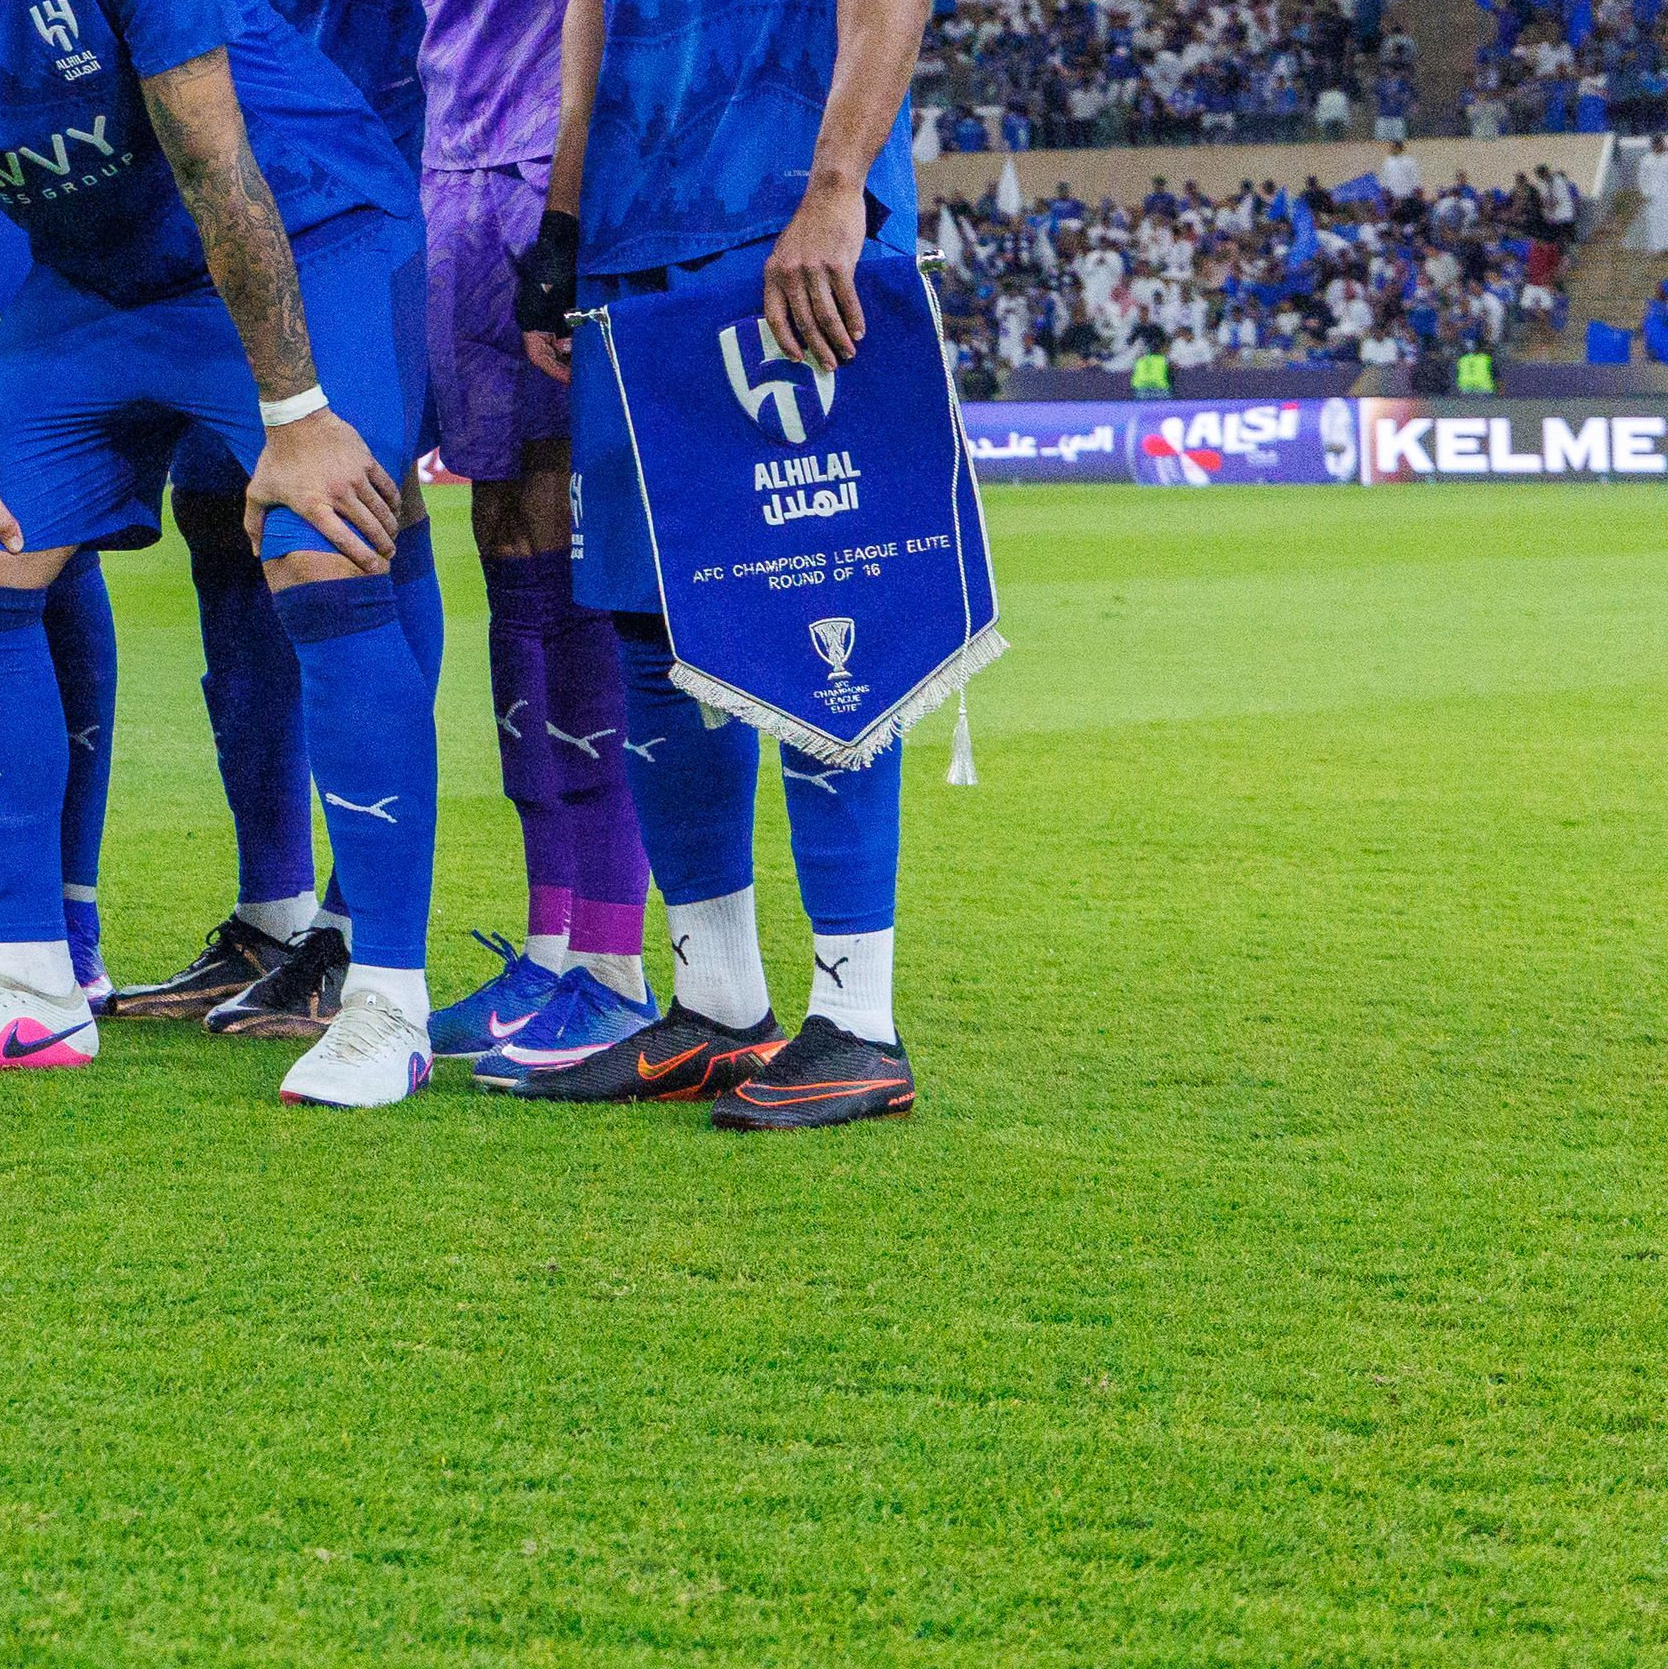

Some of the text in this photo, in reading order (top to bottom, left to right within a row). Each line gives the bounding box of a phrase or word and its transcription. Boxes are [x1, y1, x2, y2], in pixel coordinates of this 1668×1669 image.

[55, 49, 98, 71] ALHILAL
[1375, 415, 1668, 474] KELME
[753, 450, 862, 493] ALHILAL
[762, 482, 860, 527] الهلال
[692, 533, 952, 585] AFC CHAMPIONS LEAGUE ELITE
[768, 563, 881, 591] ROUND OF 16
